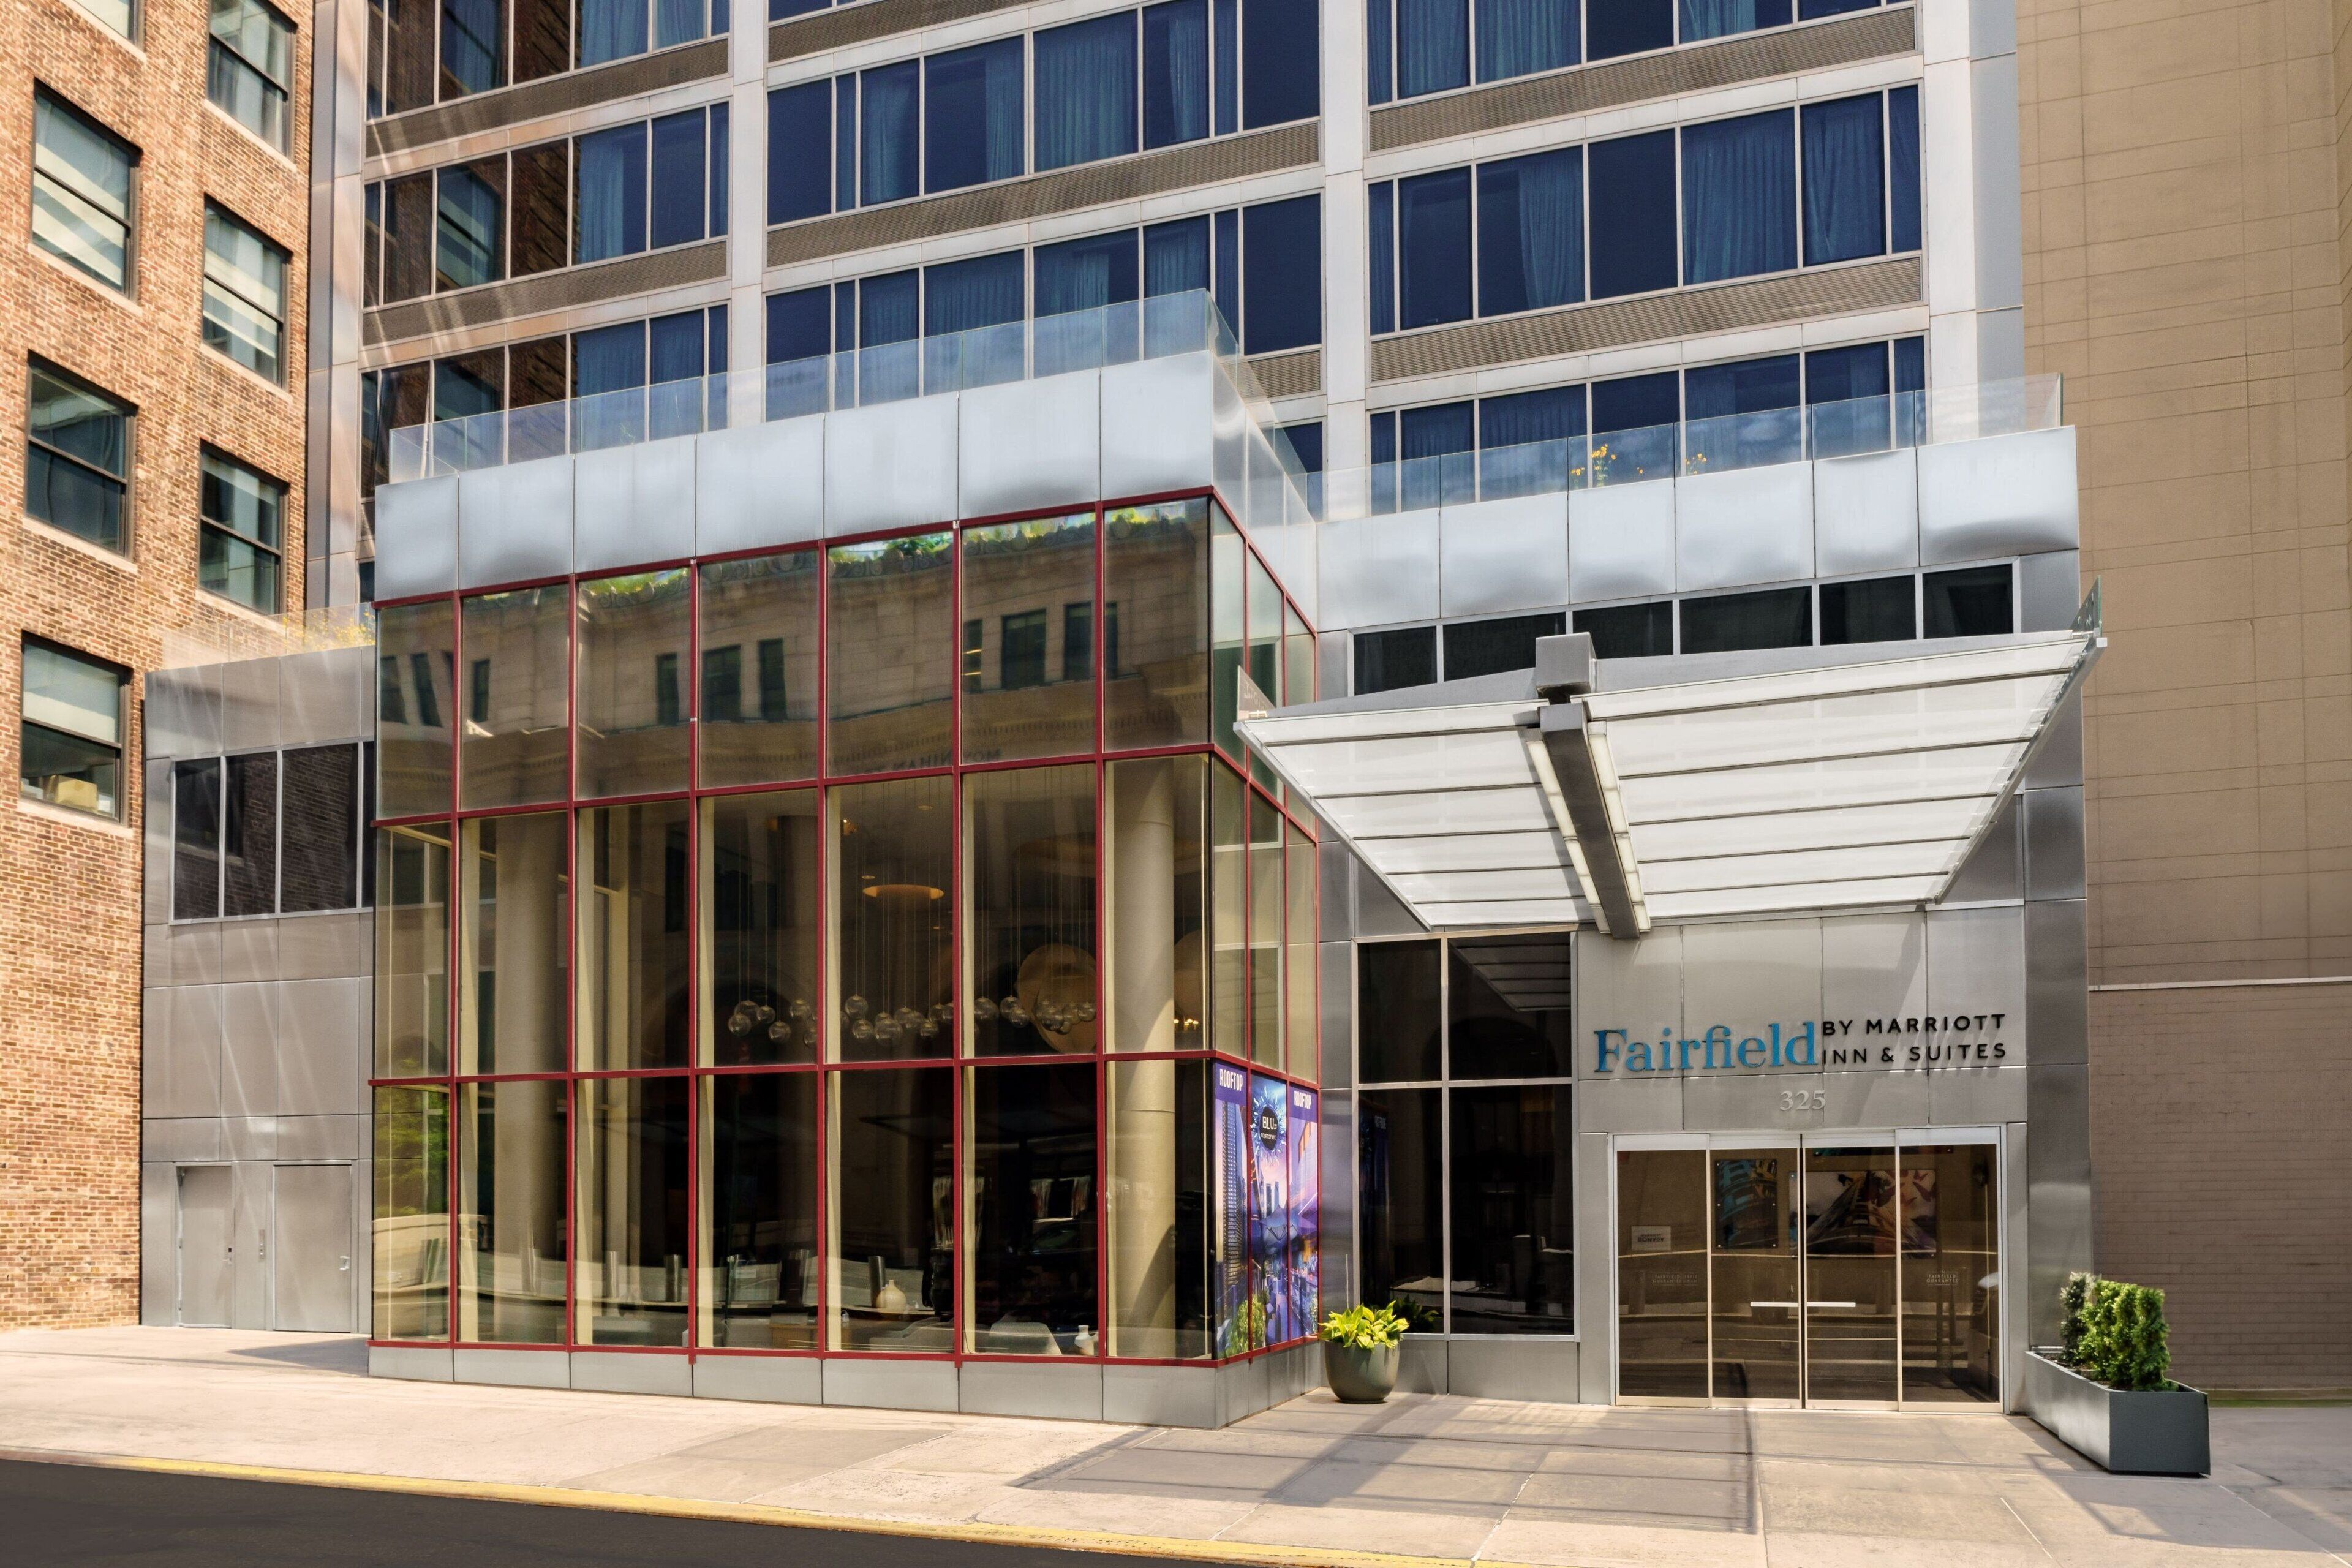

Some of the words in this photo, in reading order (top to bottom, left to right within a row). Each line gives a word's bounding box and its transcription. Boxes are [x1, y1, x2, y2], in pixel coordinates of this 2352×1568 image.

[1823, 1020, 1853, 1035] BY
[1866, 1014, 2005, 1035] MARRIOTT
[1594, 1021, 1819, 1072] Fairfield
[1823, 1048, 1867, 1065] INN
[1881, 1047, 1894, 1062] &
[1909, 1043, 2006, 1061] SUITES
[1219, 1068, 1243, 1091] ROOFTOP
[1294, 1091, 1312, 1109] ROOFTOP
[1779, 1090, 1826, 1112] 325
